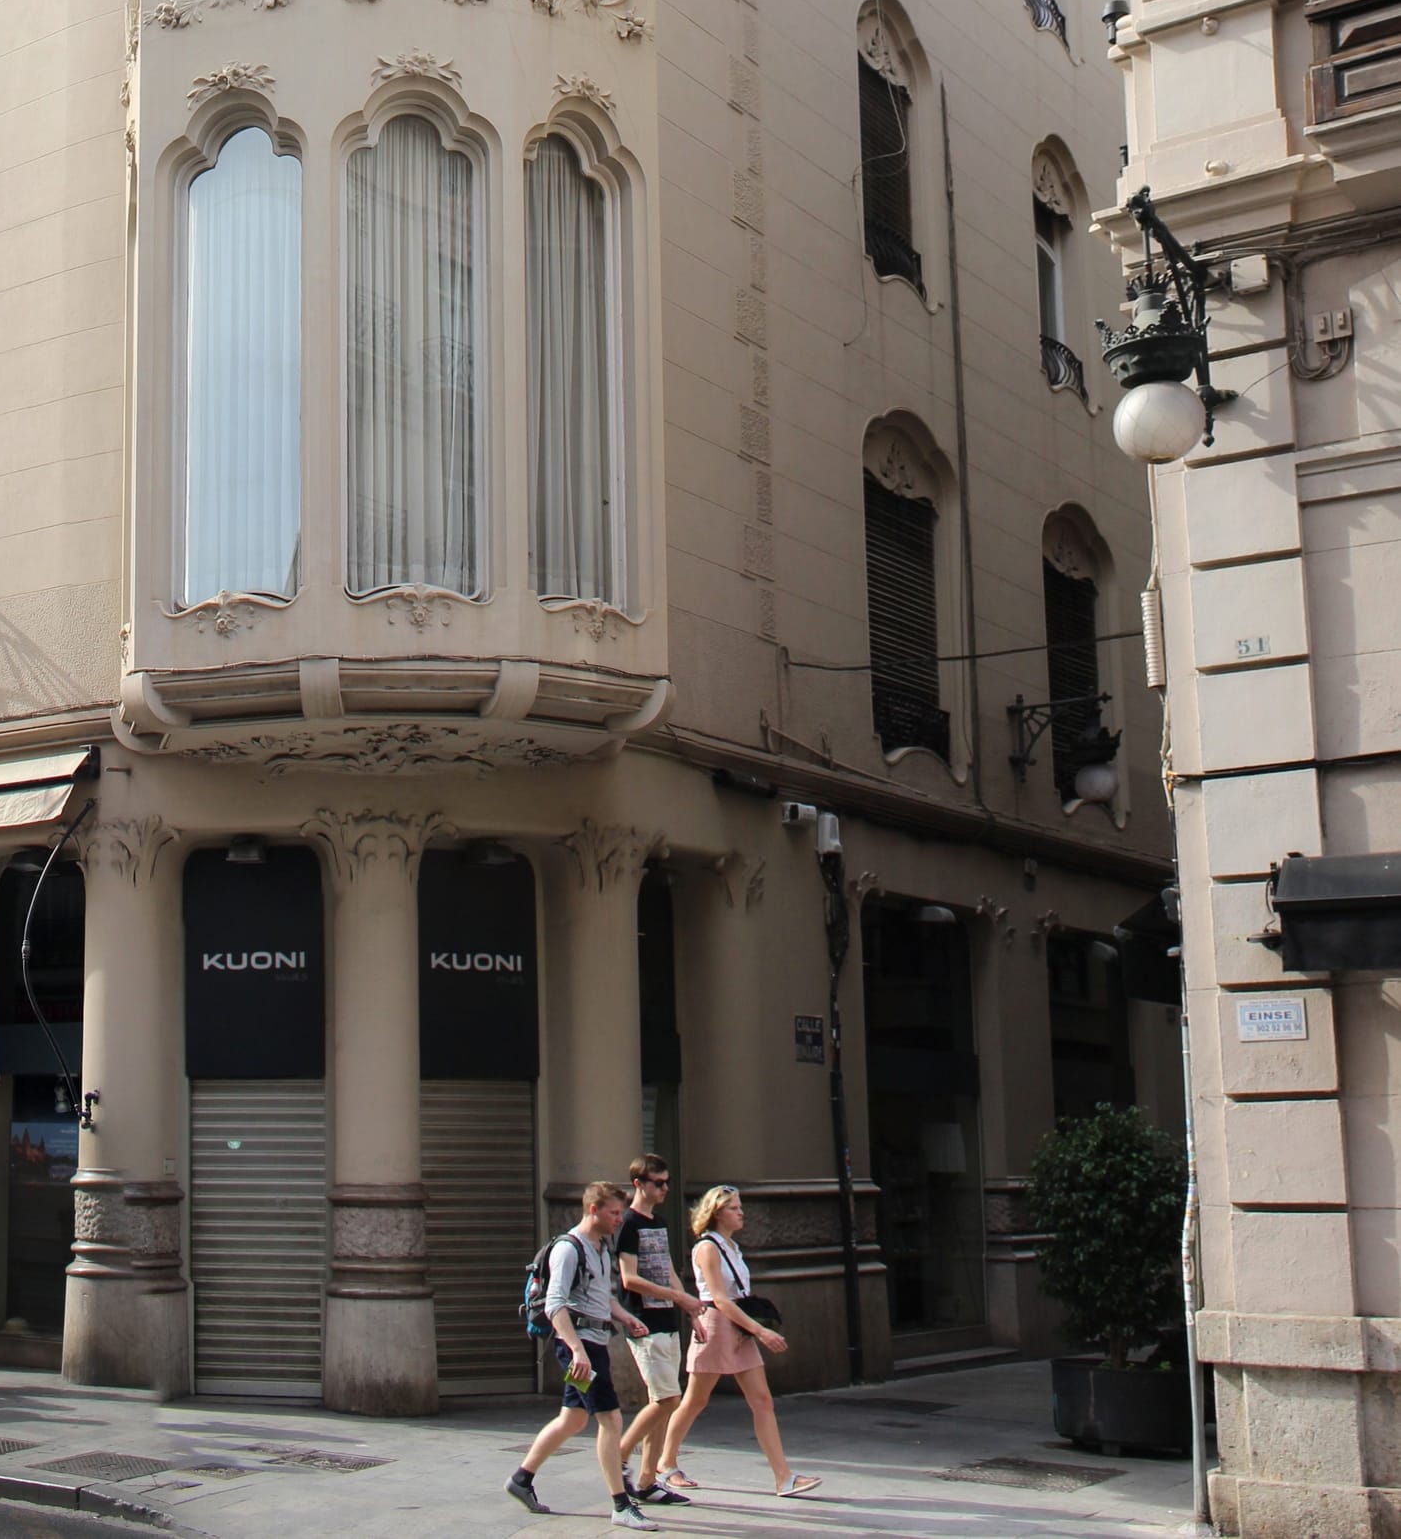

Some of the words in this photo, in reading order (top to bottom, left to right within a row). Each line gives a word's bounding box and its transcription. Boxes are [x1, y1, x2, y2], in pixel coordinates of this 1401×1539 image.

[202, 951, 306, 971] KUONI
[430, 952, 522, 972] KUONI
[1248, 1011, 1292, 1021] EINSE
